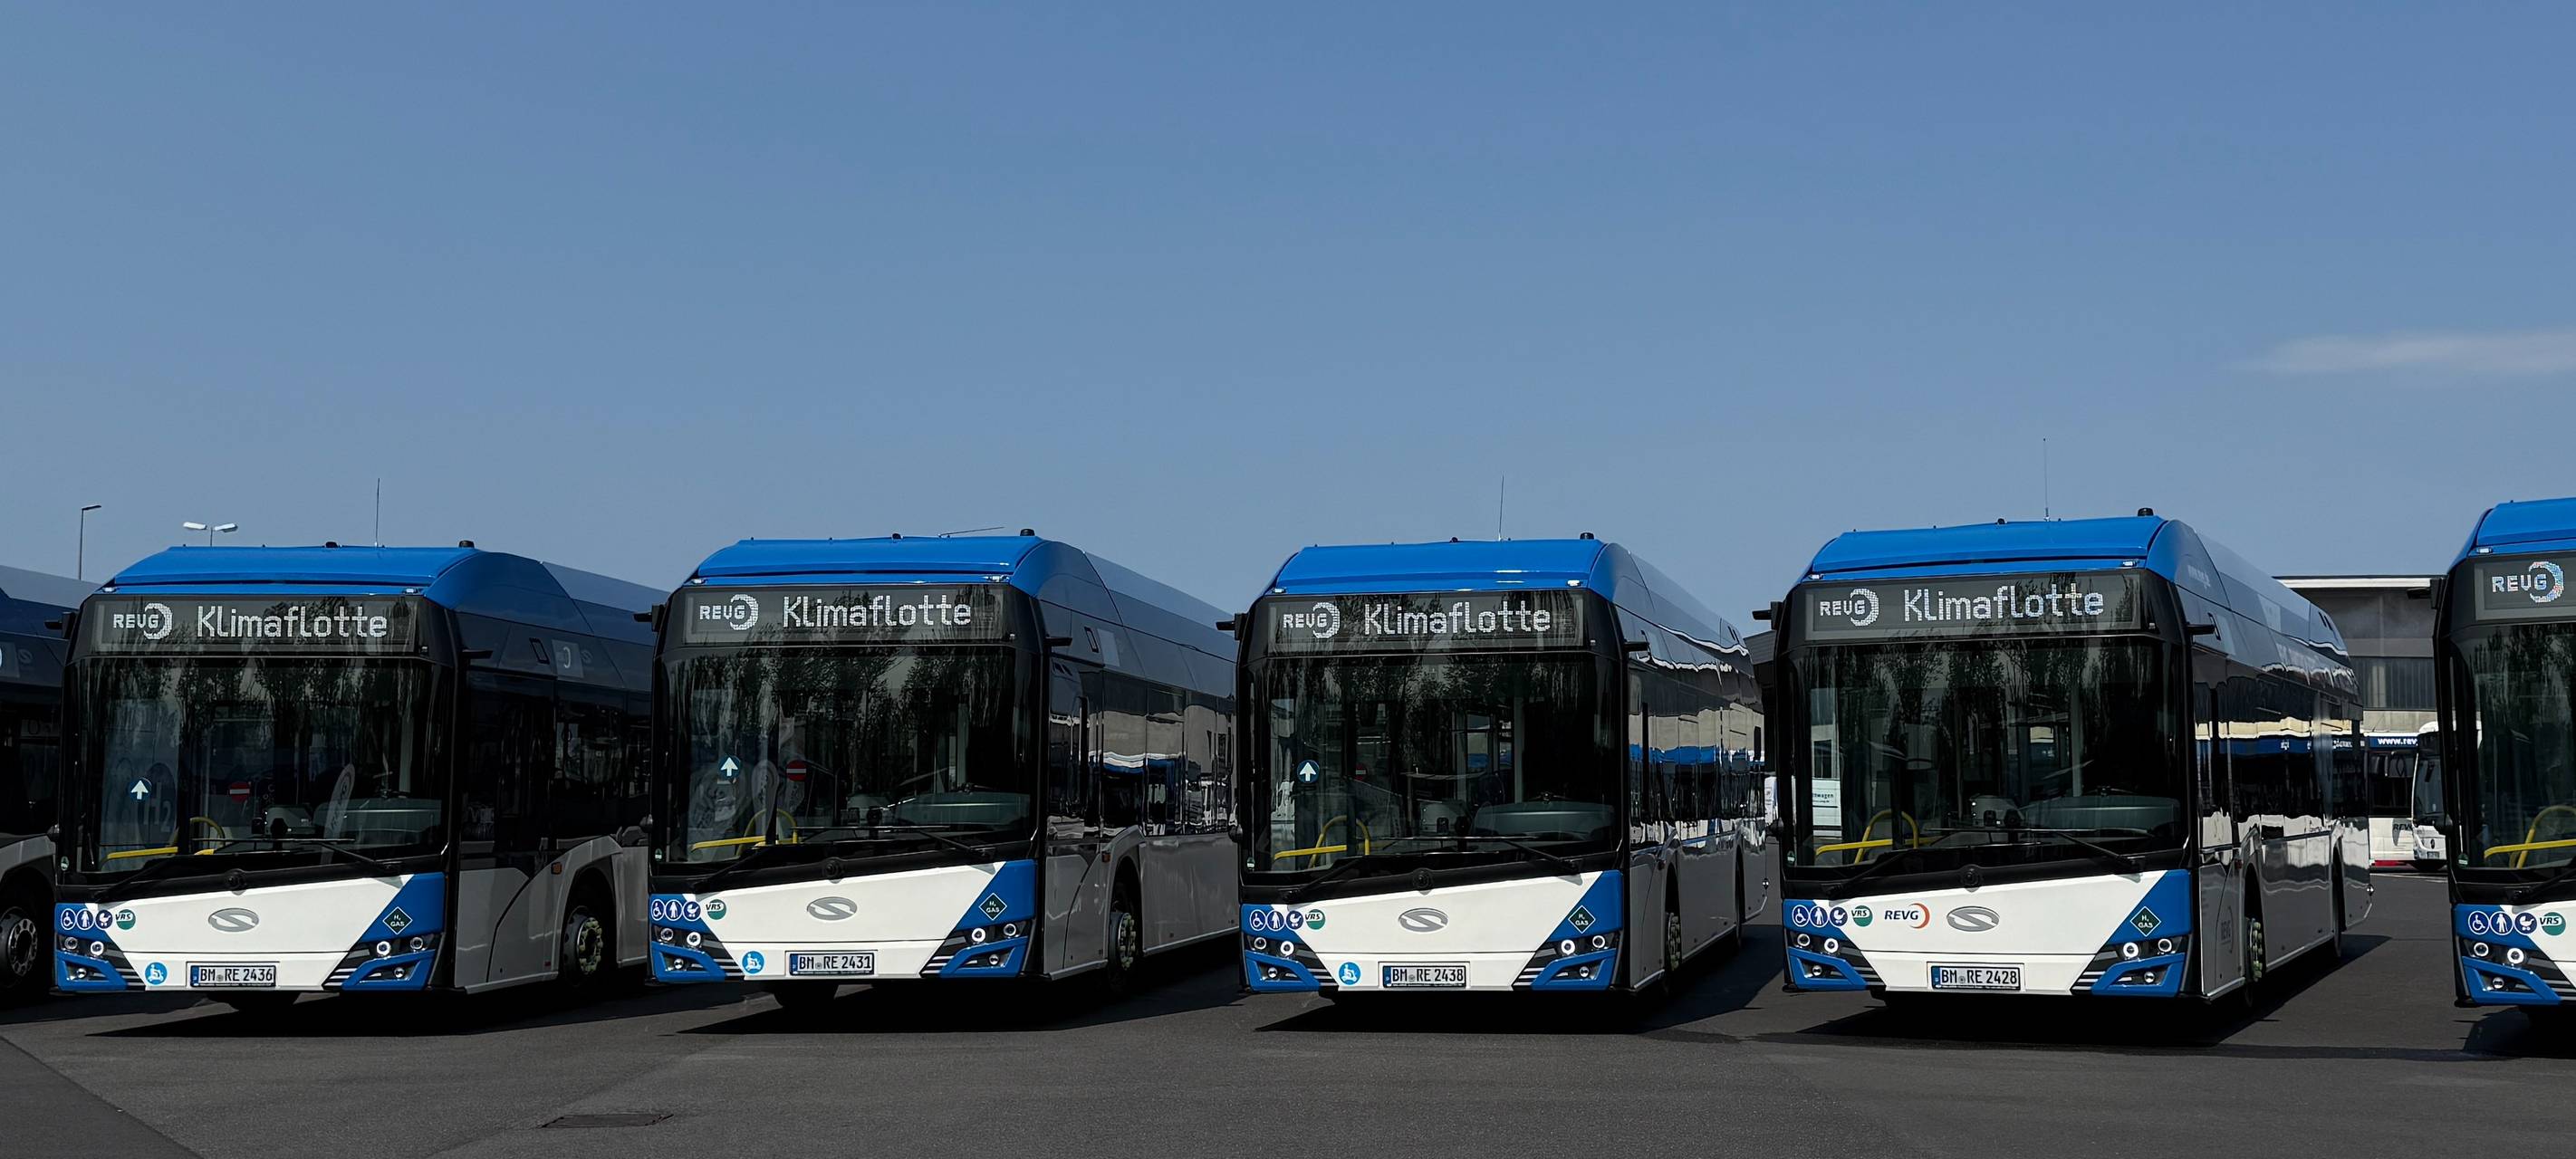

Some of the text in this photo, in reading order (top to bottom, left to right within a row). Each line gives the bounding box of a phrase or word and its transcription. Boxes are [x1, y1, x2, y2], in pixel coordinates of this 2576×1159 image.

[2492, 574, 2547, 593] REVG
[1820, 583, 2104, 622] REVG Klimaflotte
[699, 594, 972, 628] REVG Klimaflotte
[113, 606, 388, 637] REVG Klimaflotte
[1283, 600, 1551, 636] REVG Klimaflotte
[2377, 738, 2418, 746] www.rev
[705, 903, 721, 911] VRS
[1850, 909, 1868, 917] VRS
[115, 913, 131, 921] VRS
[1304, 913, 1321, 921] VRS
[1884, 910, 1919, 920] REVG
[2539, 916, 2560, 924] VRS
[799, 955, 871, 970] BM RE 2431
[200, 969, 273, 982] BM RE 2436
[1392, 969, 1464, 982] BM RE 2438
[1941, 970, 2017, 984] BM RE 2428
